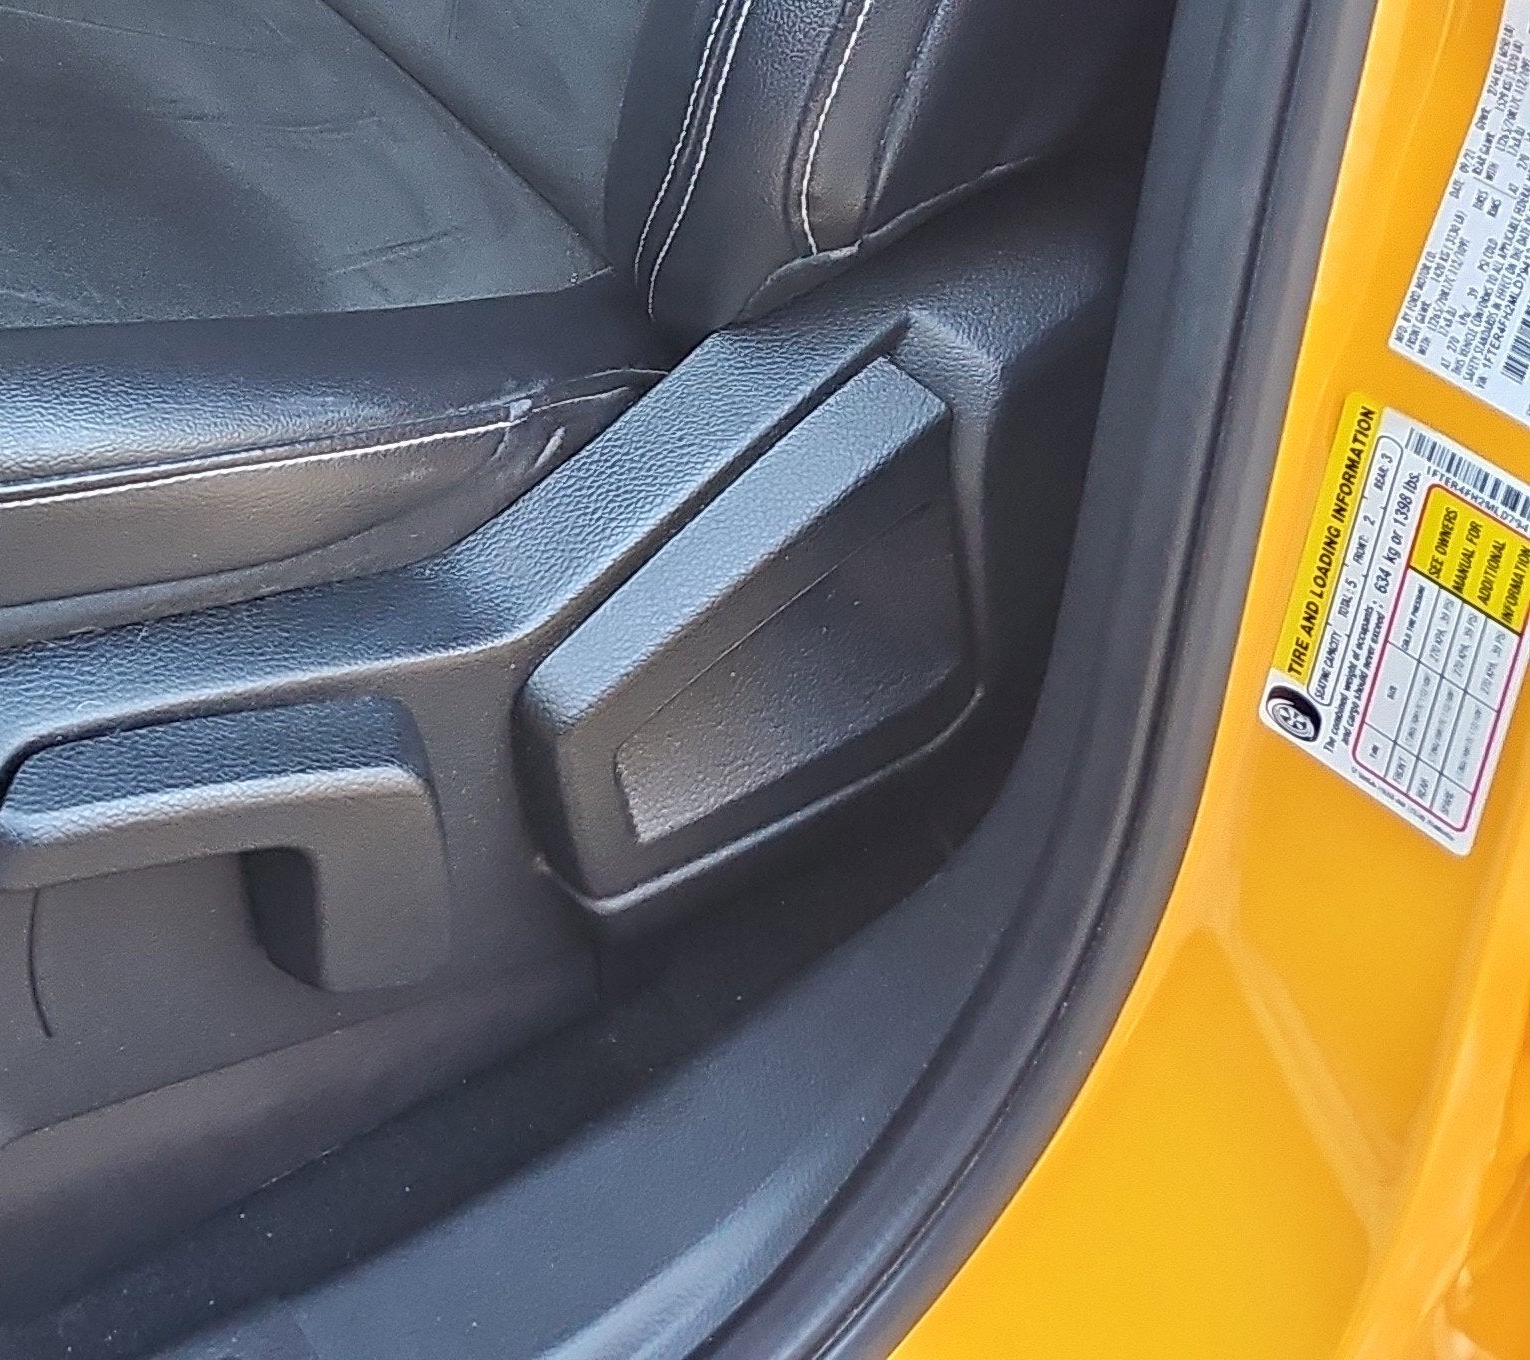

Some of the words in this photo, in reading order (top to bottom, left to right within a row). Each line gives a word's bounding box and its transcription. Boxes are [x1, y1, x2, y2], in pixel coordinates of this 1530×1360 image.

[1406, 290, 1421, 312] FORD
[1402, 472, 1421, 494] lbs.
[1345, 577, 1358, 589] 5
[1362, 514, 1376, 526] 2
[1380, 452, 1393, 464] 3
[1393, 493, 1413, 527] 1398
[1287, 637, 1310, 675] TIRE
[1300, 601, 1319, 637] AND
[1310, 526, 1341, 599] LOADING
[1332, 407, 1374, 523] INFORMATION
[1390, 529, 1403, 546] or
[1435, 507, 1458, 556] OWNERS
[1382, 546, 1401, 565] kg
[1428, 555, 1444, 579] SEE
[1452, 548, 1475, 594] MANUAL
[1465, 521, 1482, 546] FOR
[1374, 567, 1392, 594] 634
[1477, 540, 1506, 606] ADDITIONAL
[1501, 544, 1530, 624] INFORMATION
[1371, 610, 1385, 644] exceed
[1331, 692, 1348, 736] combined
[1344, 661, 1358, 692] weight
[1356, 605, 1374, 651] occupants
[1363, 644, 1375, 670] never
[1353, 670, 1368, 701] should
[1346, 701, 1360, 727] cargo
[1341, 726, 1352, 746] and
